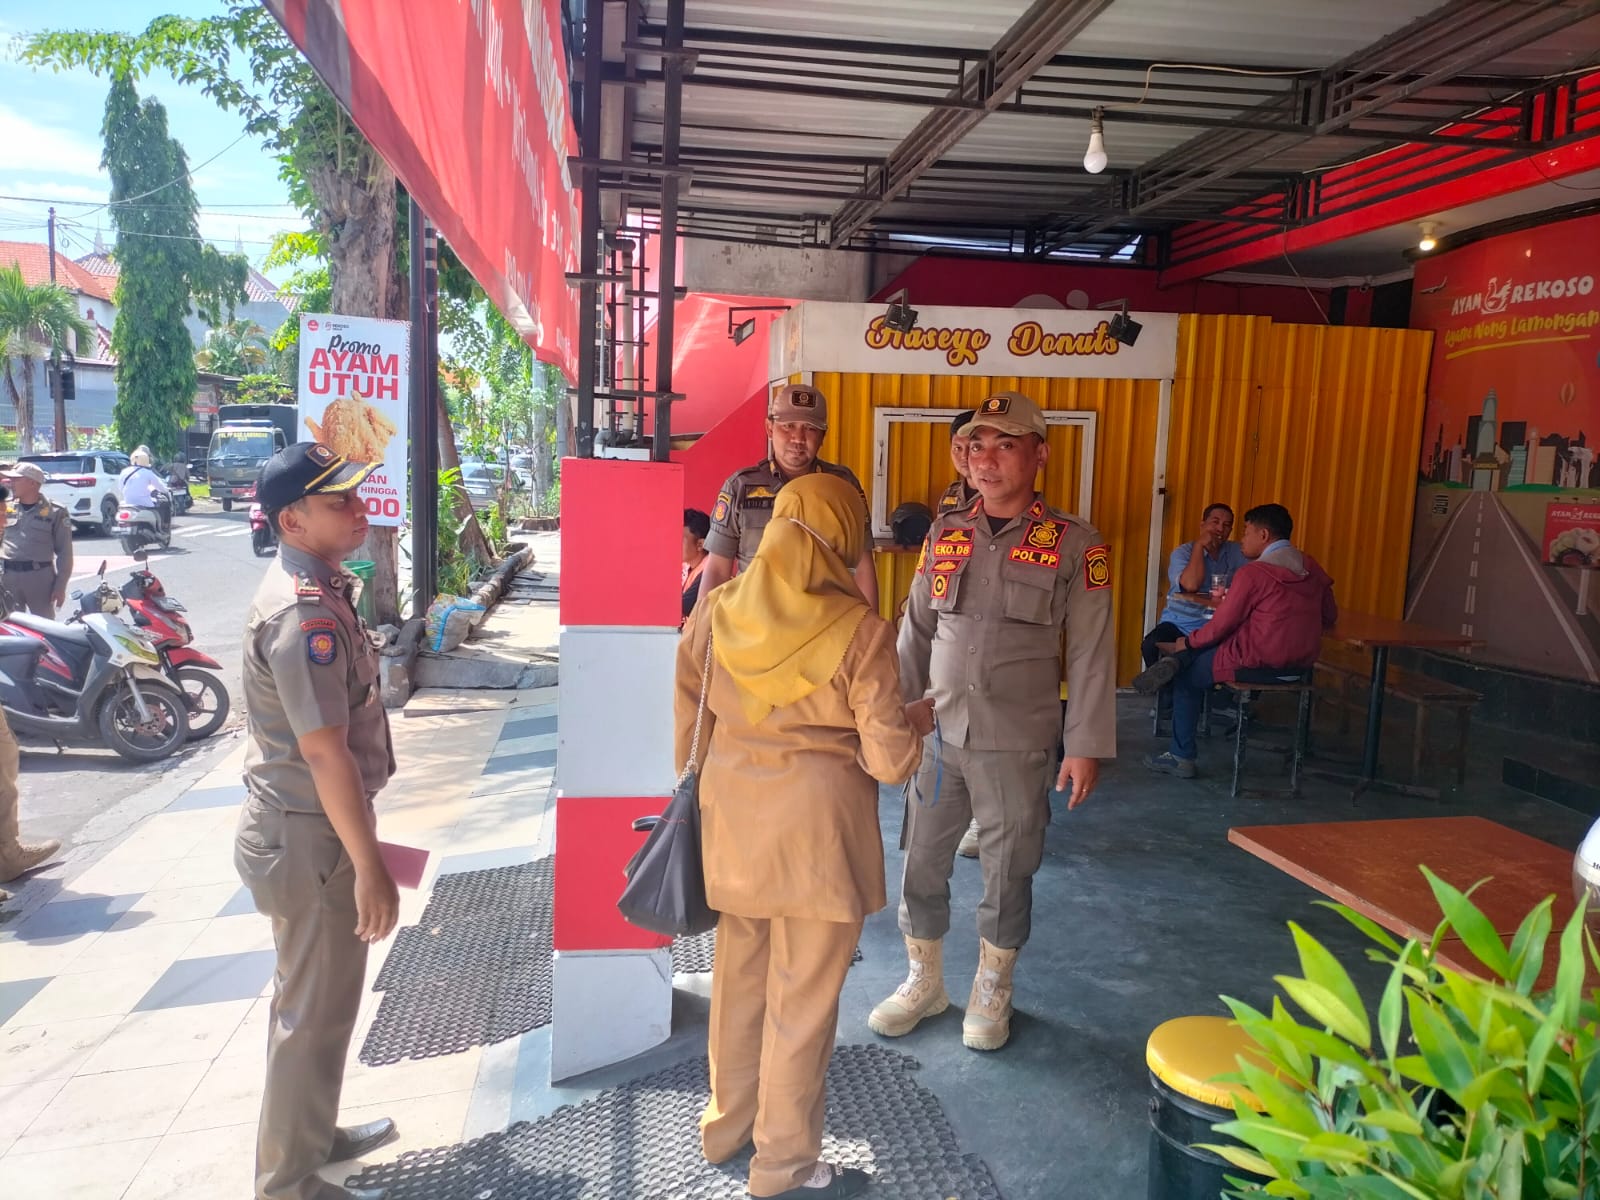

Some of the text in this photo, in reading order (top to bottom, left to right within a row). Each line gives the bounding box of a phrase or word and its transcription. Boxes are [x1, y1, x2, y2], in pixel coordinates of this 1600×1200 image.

[1451, 275, 1594, 316] AYAM REKOSO
[1008, 320, 1119, 356] Donuts
[1474, 321, 1507, 339] Nong
[1511, 310, 1599, 334] Lamongan
[327, 334, 381, 355] Promo
[309, 347, 398, 376] AYAM
[308, 371, 398, 401] UTUH
[360, 486, 398, 495] HINGGA
[366, 474, 387, 484] AN
[1011, 549, 1057, 566] POL PP
